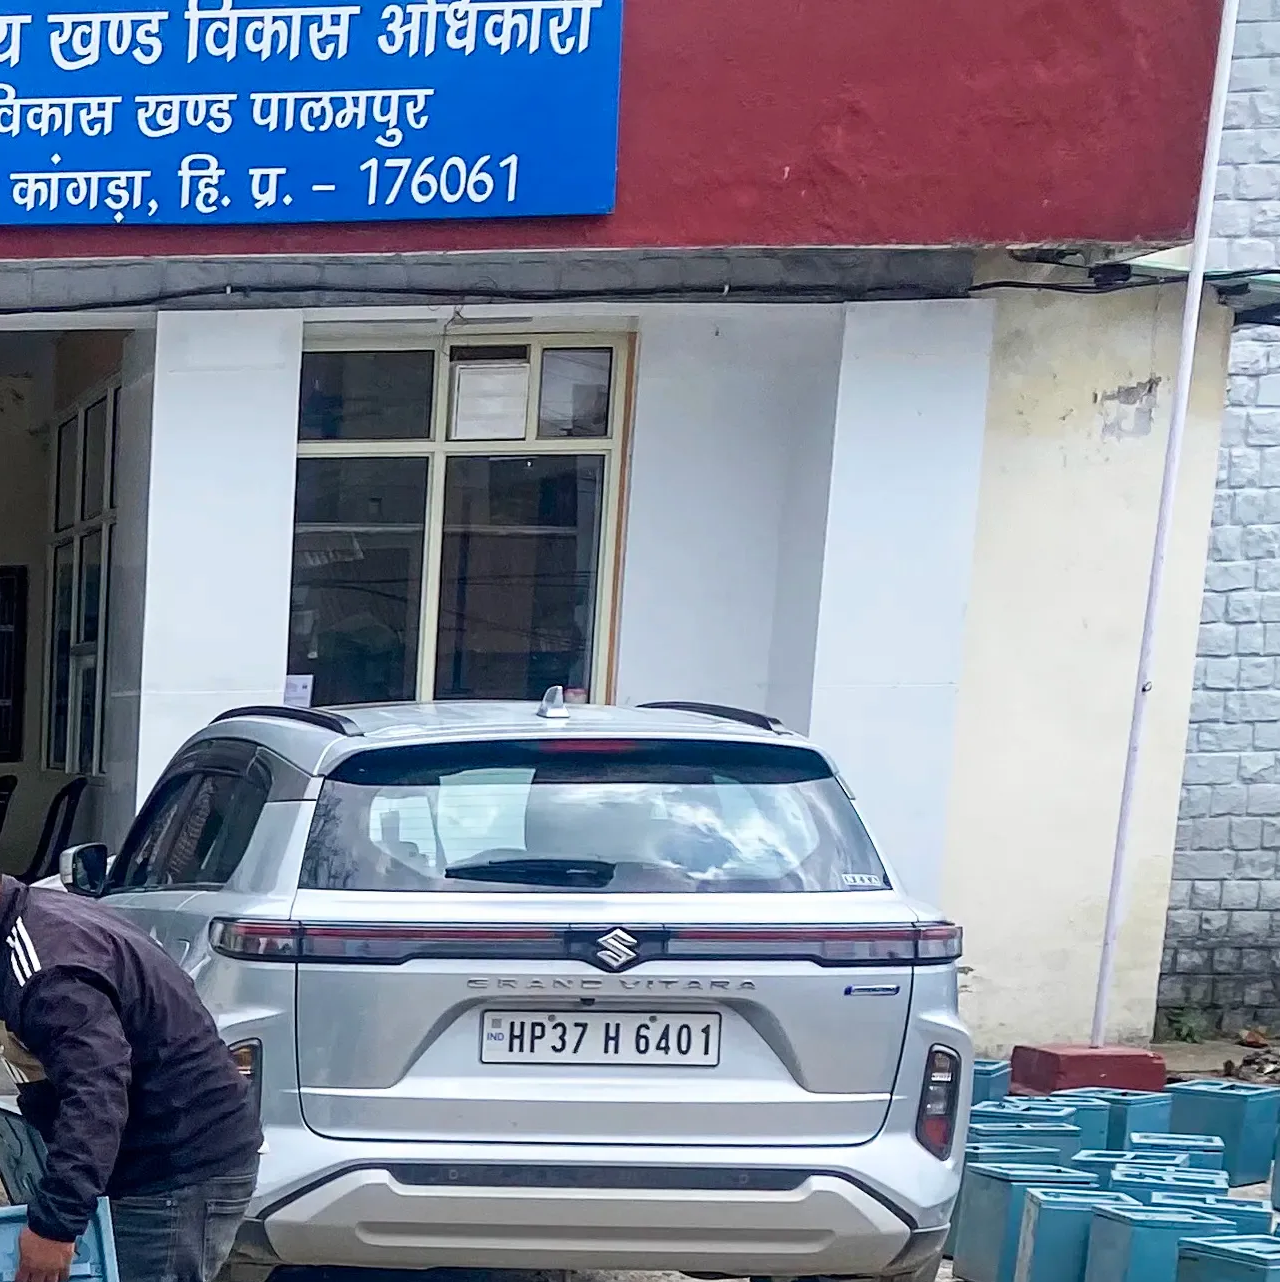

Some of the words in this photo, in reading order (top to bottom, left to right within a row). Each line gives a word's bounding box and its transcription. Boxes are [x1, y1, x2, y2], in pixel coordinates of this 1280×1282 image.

[47, 11, 169, 71] खण्ड
[185, 0, 360, 63] विकास
[135, 94, 237, 138] खण्ड
[250, 88, 434, 147] पालमपुर
[178, 153, 231, 213] हि.
[249, 167, 294, 209] प्र.
[360, 153, 519, 206] 176061
[467, 978, 603, 990] GRAND
[619, 979, 757, 991] VITARA
[487, 1032, 504, 1041] IND
[603, 1022, 621, 1054] H
[635, 1023, 711, 1056] 6401
